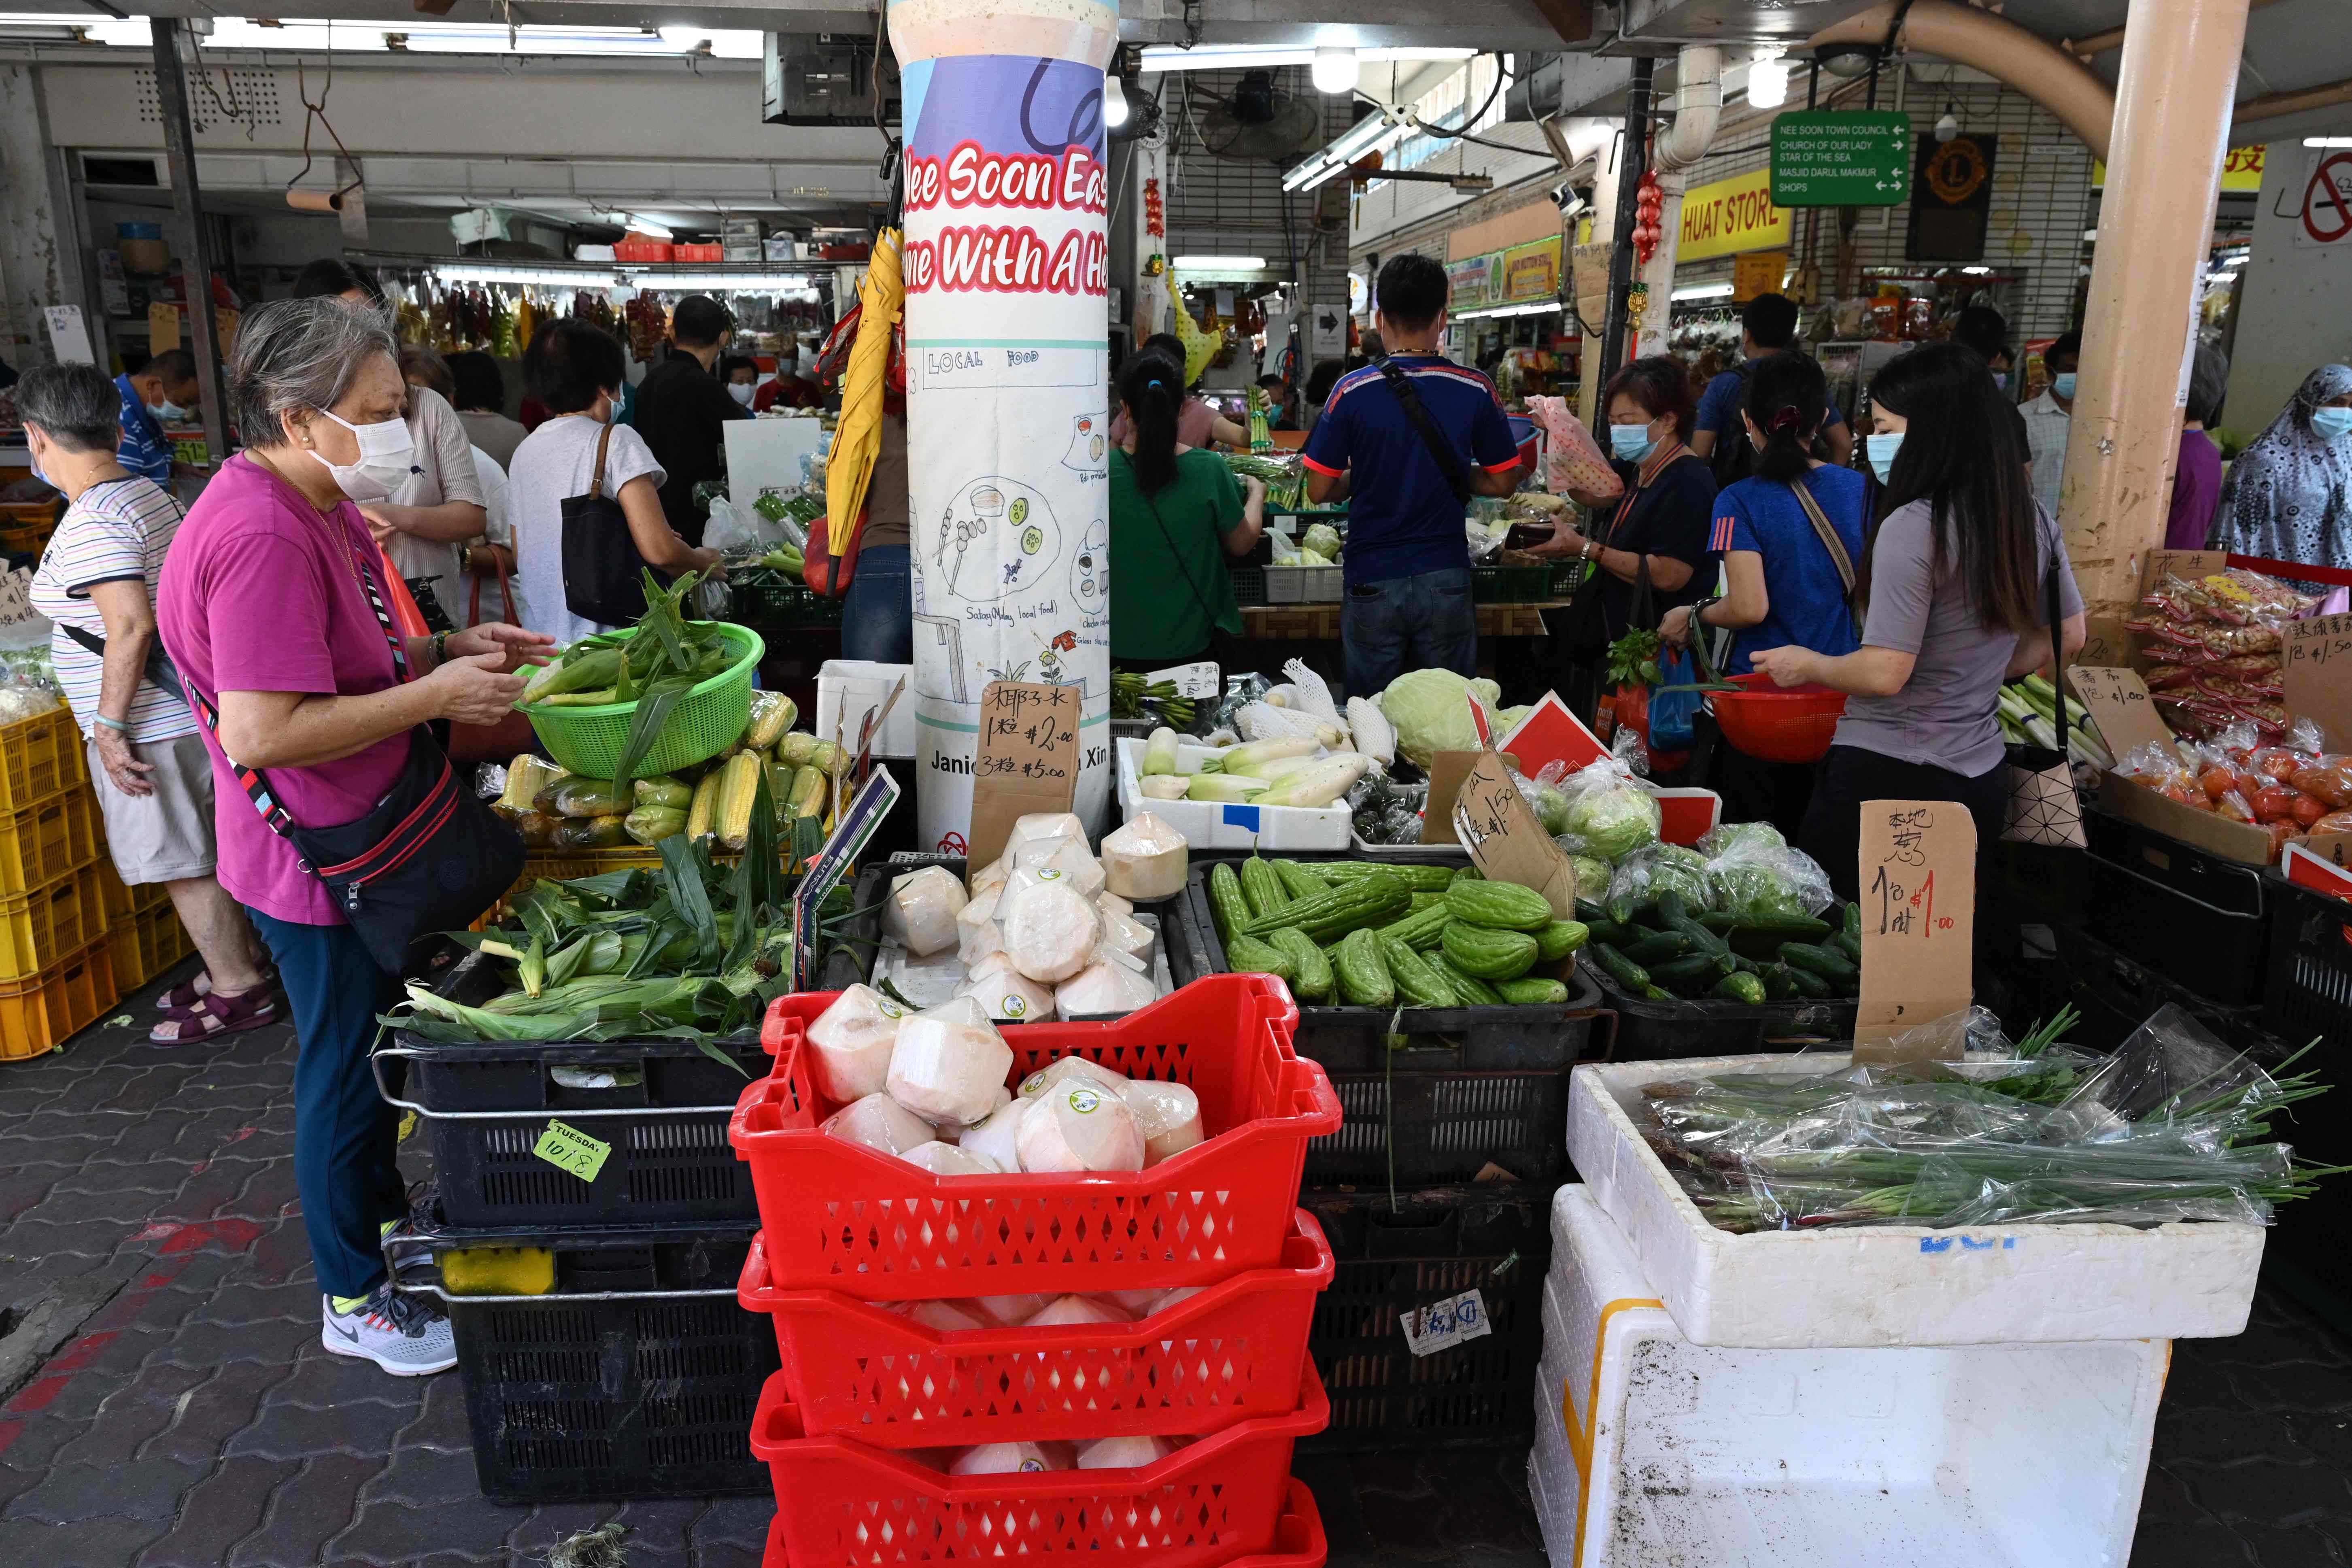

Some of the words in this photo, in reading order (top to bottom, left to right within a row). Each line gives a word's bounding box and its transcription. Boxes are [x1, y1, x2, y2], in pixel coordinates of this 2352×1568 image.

[1780, 126, 1797, 135] NEE
[1799, 126, 1823, 135] SOON
[1825, 126, 1850, 135] TOWN
[1852, 125, 1888, 135] COUNCIL
[1780, 140, 1816, 150] CHURCH
[1817, 140, 1829, 150] OF
[1830, 140, 1849, 150] OUR
[1851, 140, 1872, 150] LADY
[1779, 153, 1801, 162] STAR
[1802, 153, 1814, 162] OF
[1817, 153, 1832, 162] THE
[1834, 153, 1851, 162] SEA
[947, 147, 1053, 205] Soon
[1779, 168, 1809, 177] MASJID
[1810, 168, 1838, 177] DARUL
[1840, 168, 1877, 177] MAKMUR
[1778, 183, 1808, 192] SHOPS
[1683, 200, 1722, 243] HUAT
[941, 230, 1043, 288] With
[1049, 234, 1080, 291] A
[928, 351, 984, 375] LOCAL
[1007, 350, 1039, 367] FOOD
[967, 606, 992, 627] Satay
[1018, 606, 1037, 619] local
[985, 686, 1069, 719] 椰子水
[2111, 685, 2145, 705] $1.00
[1597, 707, 1613, 720] north
[1597, 718, 1610, 731] west
[1086, 746, 1106, 769] Xin
[1889, 807, 1933, 830] 本地
[1910, 870, 1955, 938] $1.00
